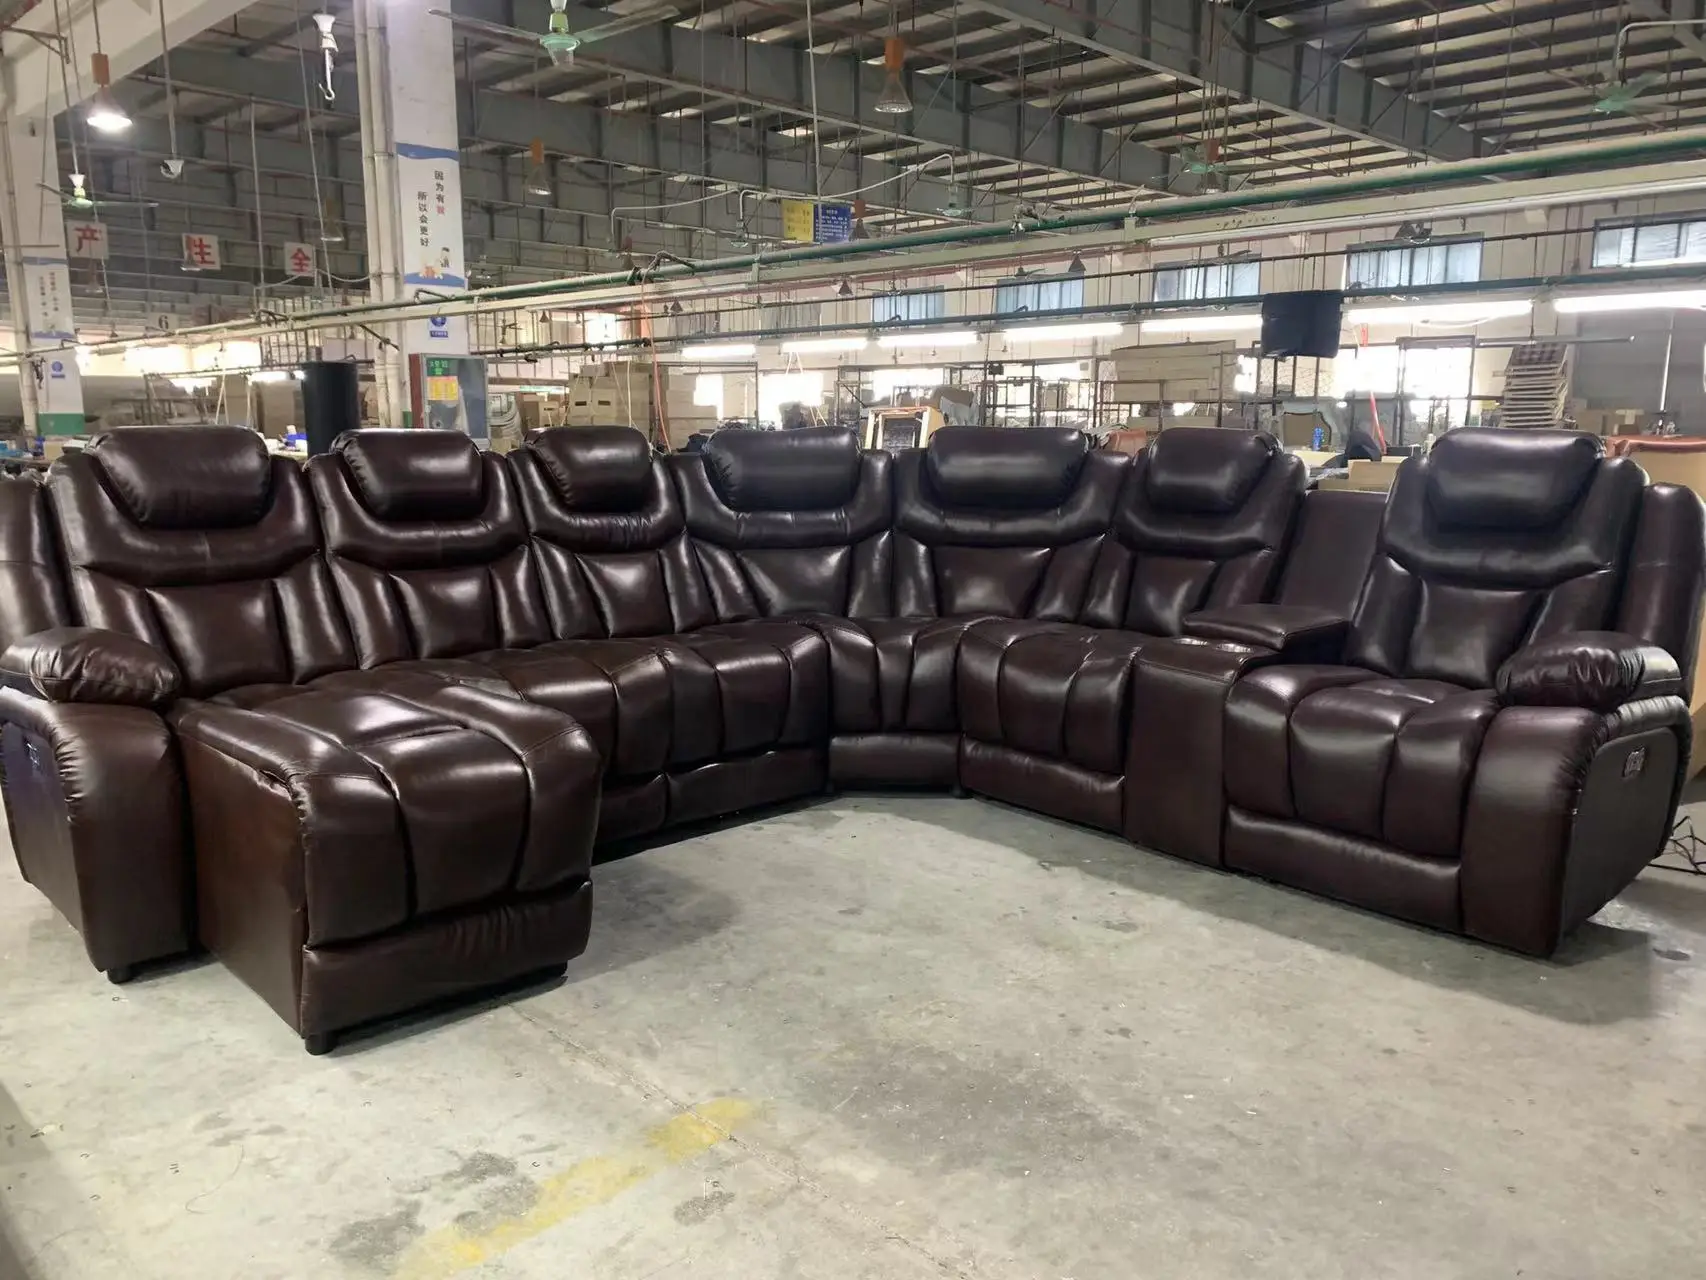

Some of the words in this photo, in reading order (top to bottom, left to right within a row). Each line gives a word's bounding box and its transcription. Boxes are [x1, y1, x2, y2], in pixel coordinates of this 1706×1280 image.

[417, 191, 429, 247] 所以会更好
[74, 224, 102, 252] 产
[188, 236, 216, 265] 生
[290, 247, 311, 273] 全
